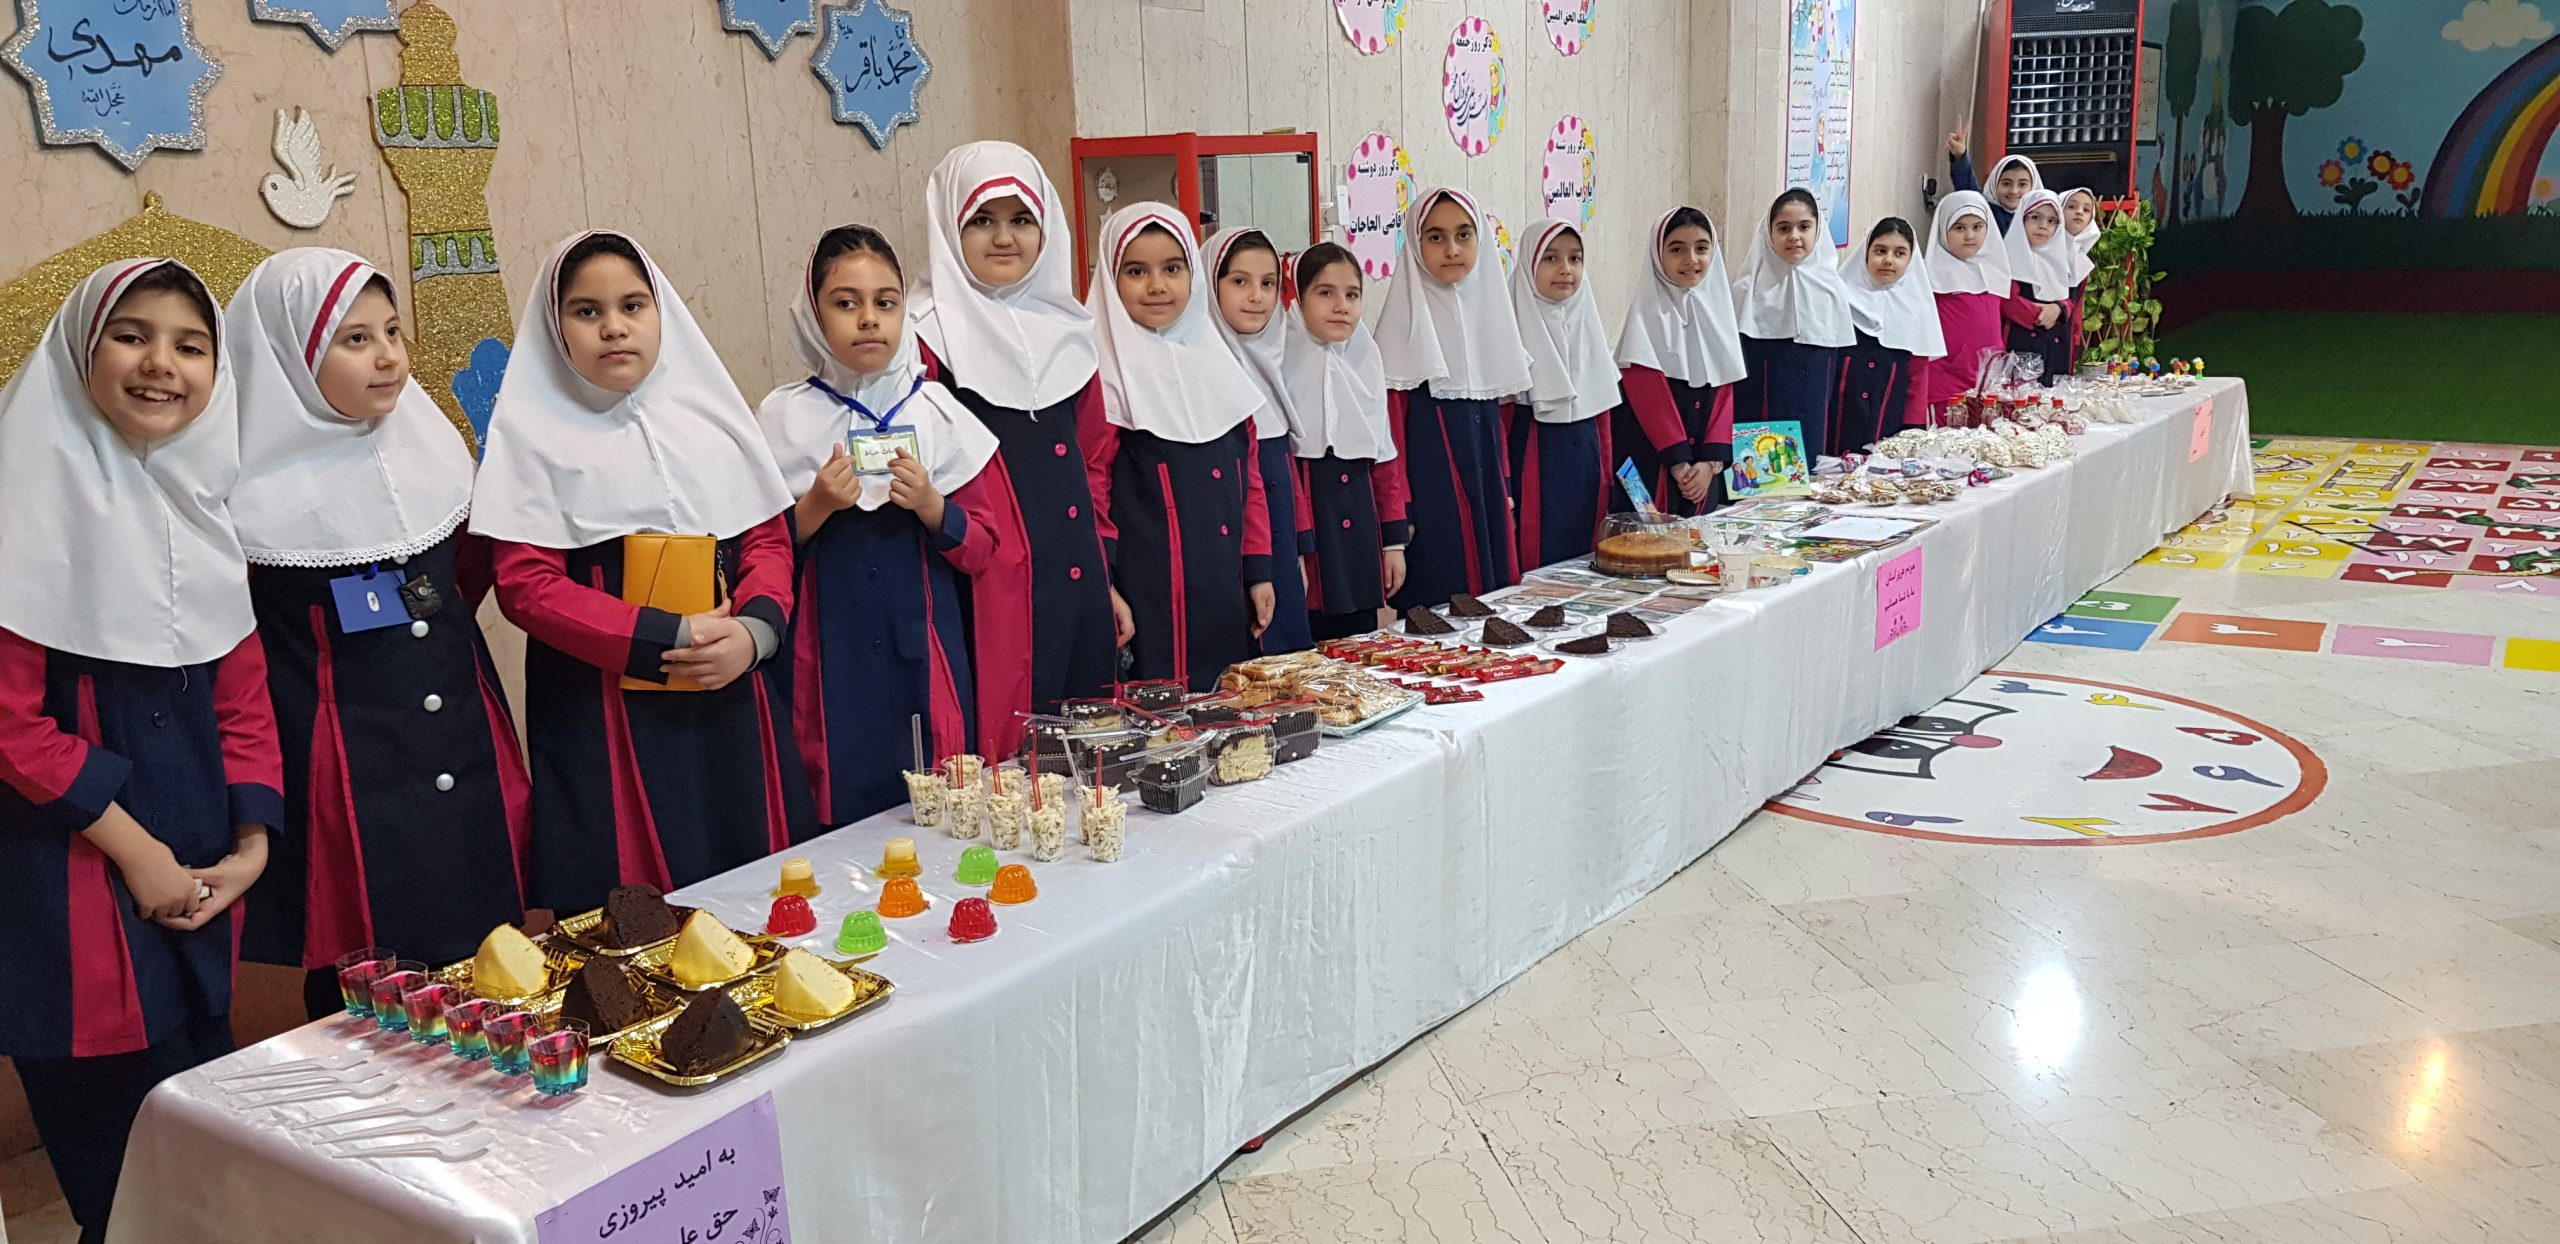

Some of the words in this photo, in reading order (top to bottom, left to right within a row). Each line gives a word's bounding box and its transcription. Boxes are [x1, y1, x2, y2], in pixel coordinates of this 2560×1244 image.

[48, 18, 183, 78] مهدی
[674, 1149, 712, 1189] امید
[718, 1148, 735, 1165] به
[599, 1187, 667, 1239] پیروزی
[706, 1208, 739, 1241] حق
